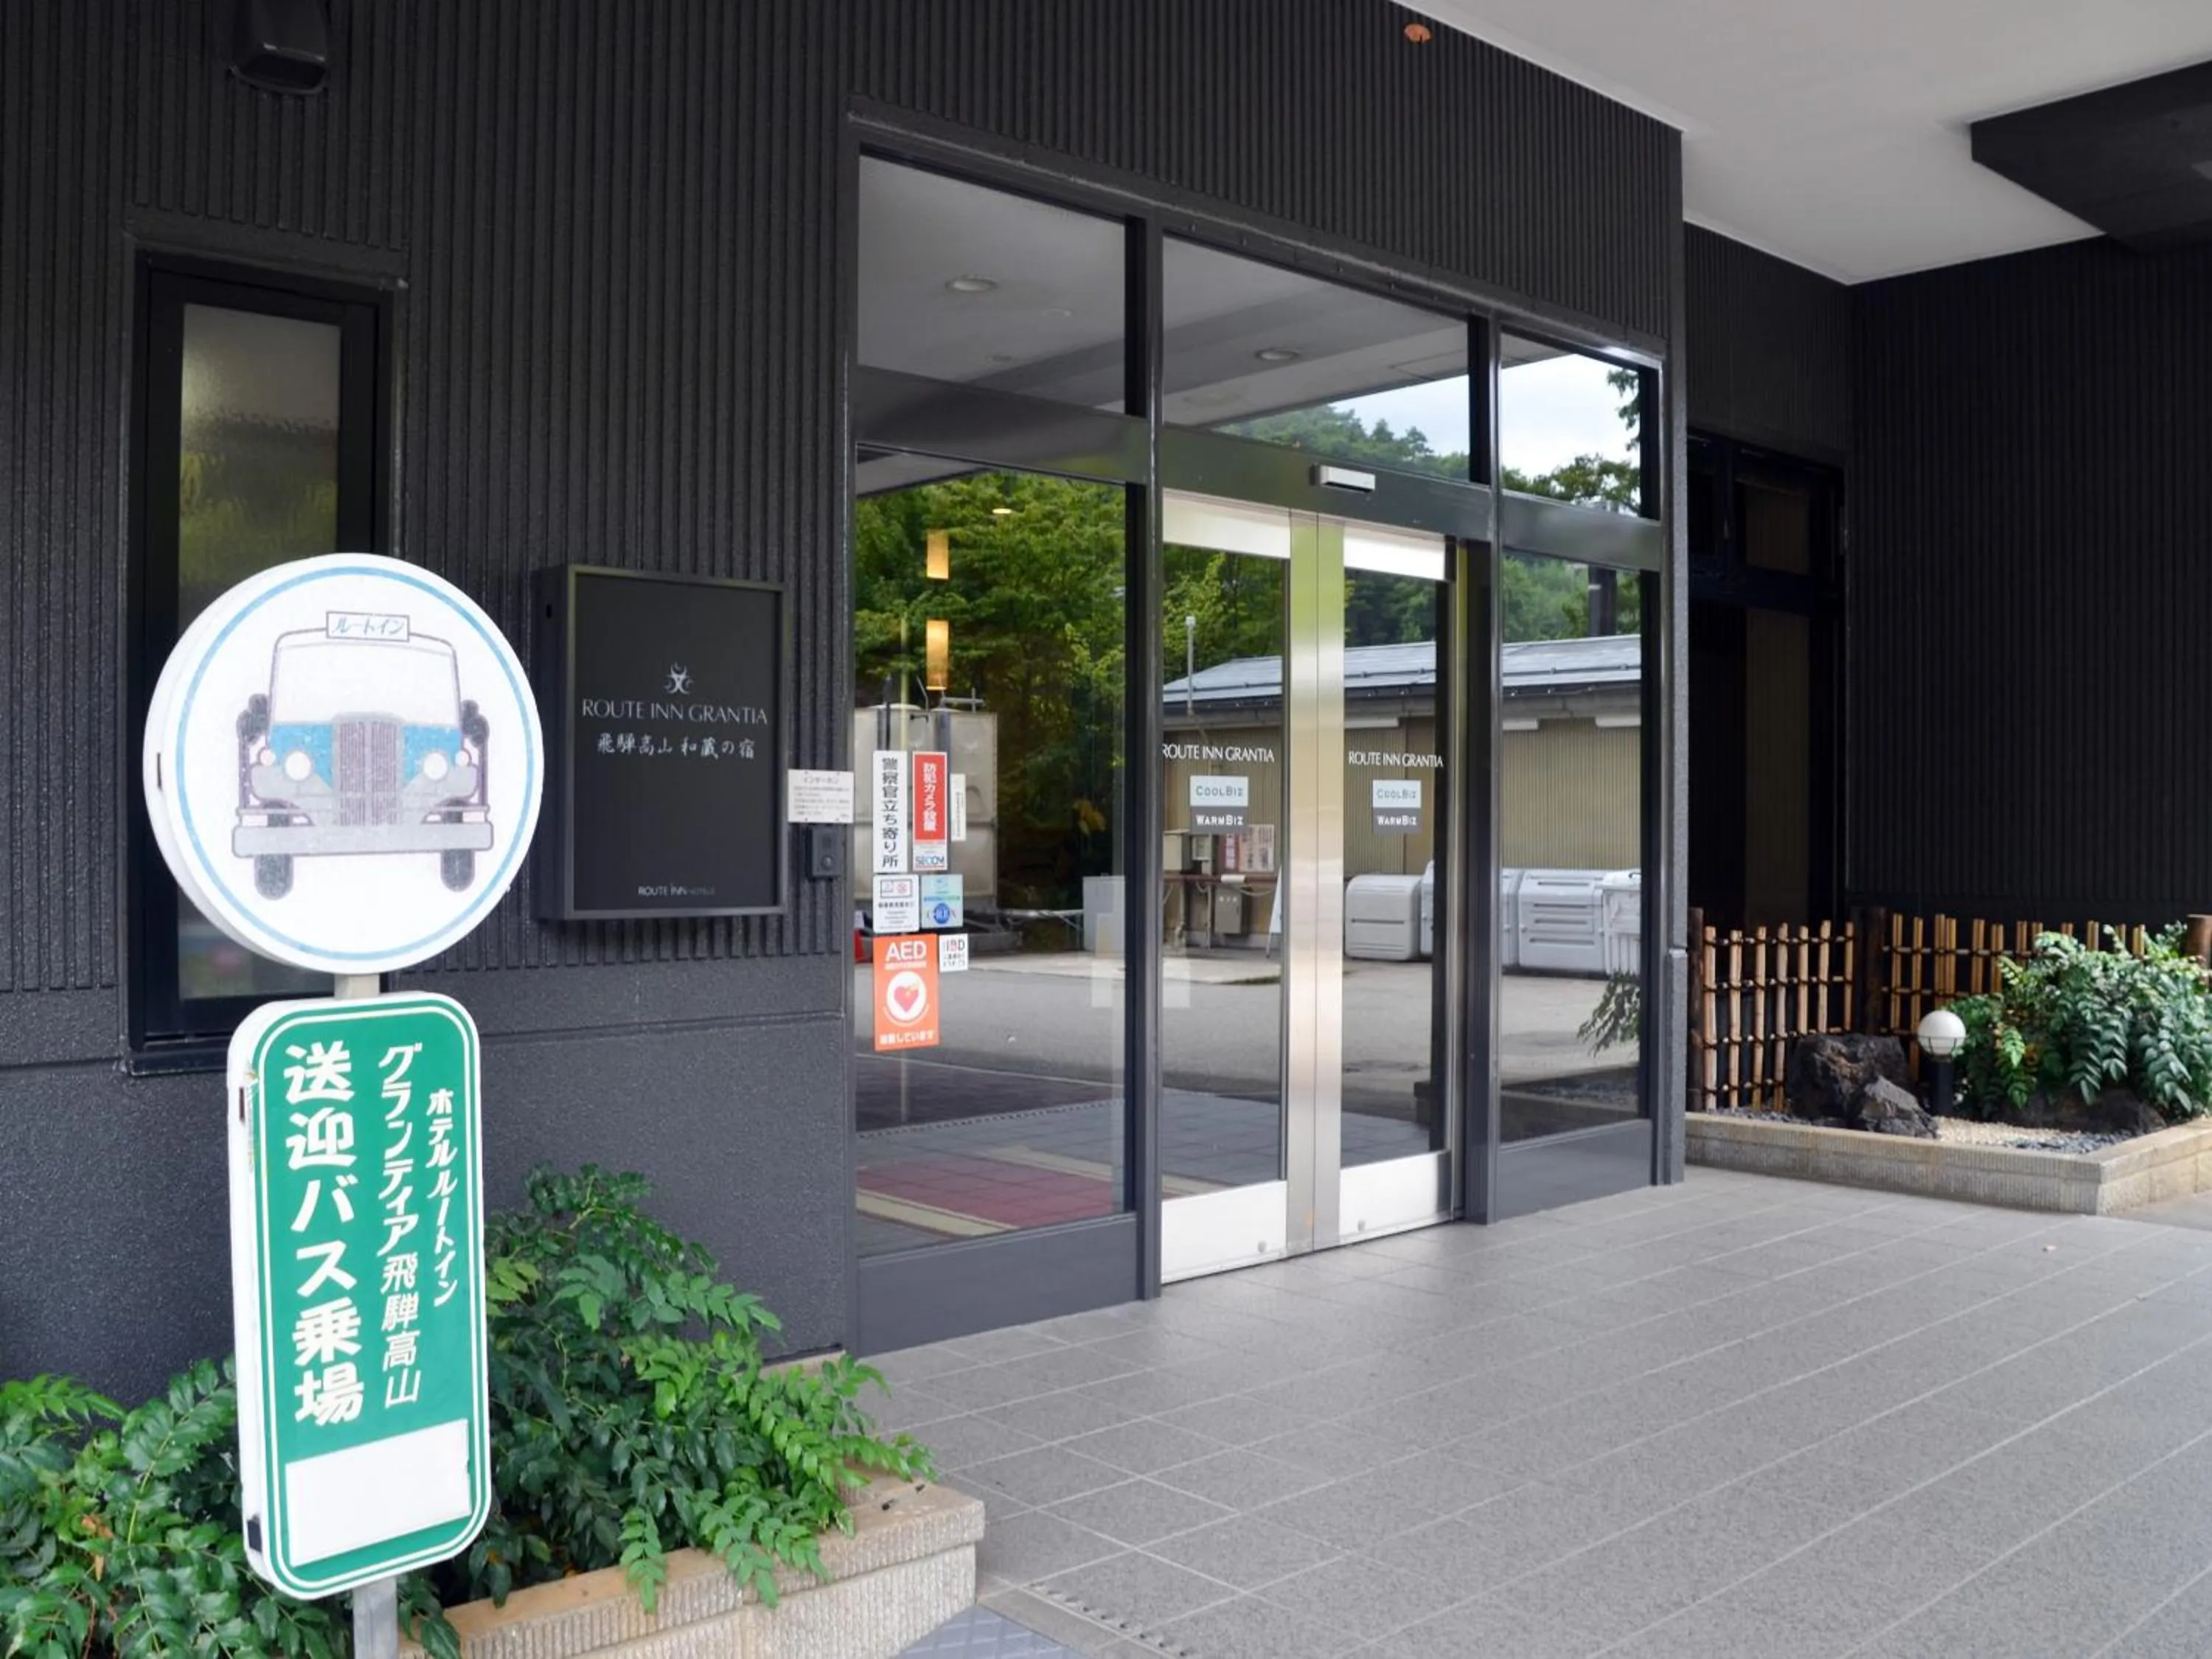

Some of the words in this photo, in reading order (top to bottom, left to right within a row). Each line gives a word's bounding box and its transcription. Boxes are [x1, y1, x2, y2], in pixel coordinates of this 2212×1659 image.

[331, 616, 405, 636] ルートイン
[582, 698, 645, 719] ROUTE
[650, 701, 684, 720] INN
[688, 704, 768, 726] GRANTIA
[1162, 743, 1200, 760] ROUTE
[1202, 745, 1224, 760] INN
[1225, 746, 1276, 763] GRANTIA
[1348, 751, 1382, 766] ROUTE
[1382, 751, 1402, 766] INN
[1402, 753, 1444, 768] GRANTIA
[882, 757, 899, 868] 警察官立ち寄り所
[915, 855, 945, 866] SECOM
[638, 885, 668, 897] ROUTE
[670, 883, 688, 896] INN
[885, 940, 928, 962] AED
[427, 1088, 459, 1308] ホテルルートイン
[283, 1040, 365, 1427] 送迎バス乗場
